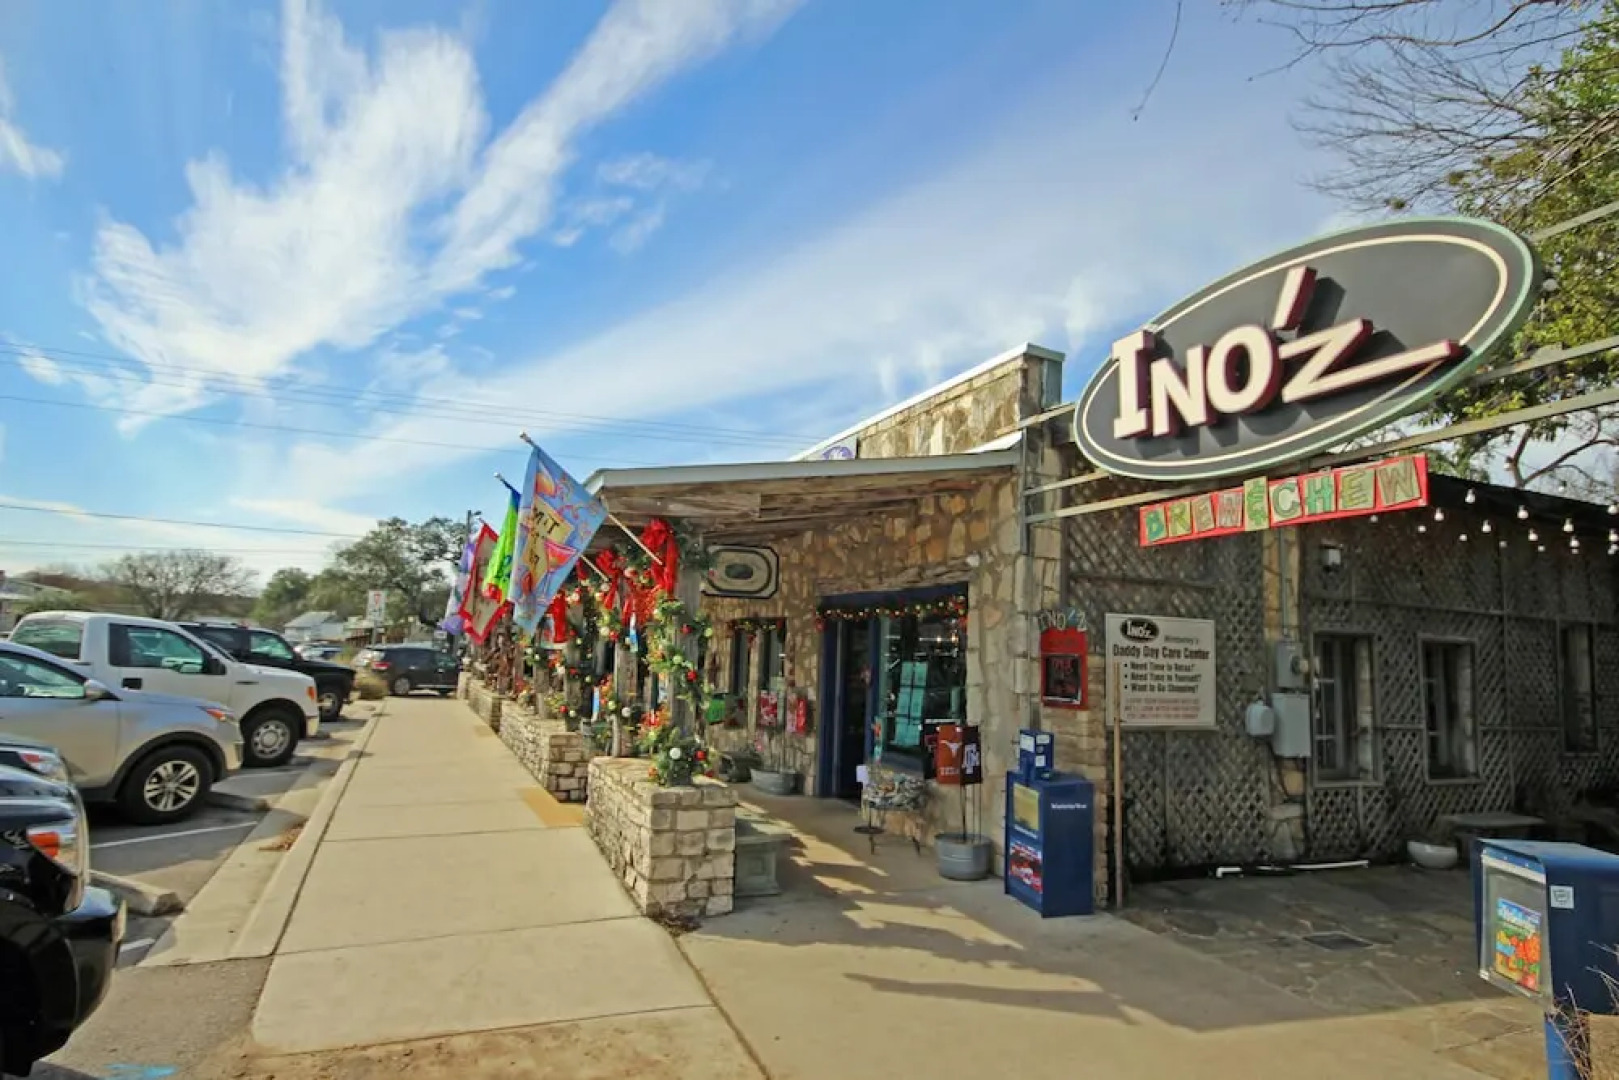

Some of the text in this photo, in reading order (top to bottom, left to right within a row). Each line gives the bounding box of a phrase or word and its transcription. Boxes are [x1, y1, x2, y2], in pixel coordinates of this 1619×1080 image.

[1113, 644, 1210, 660] Daddy Day Care Center
